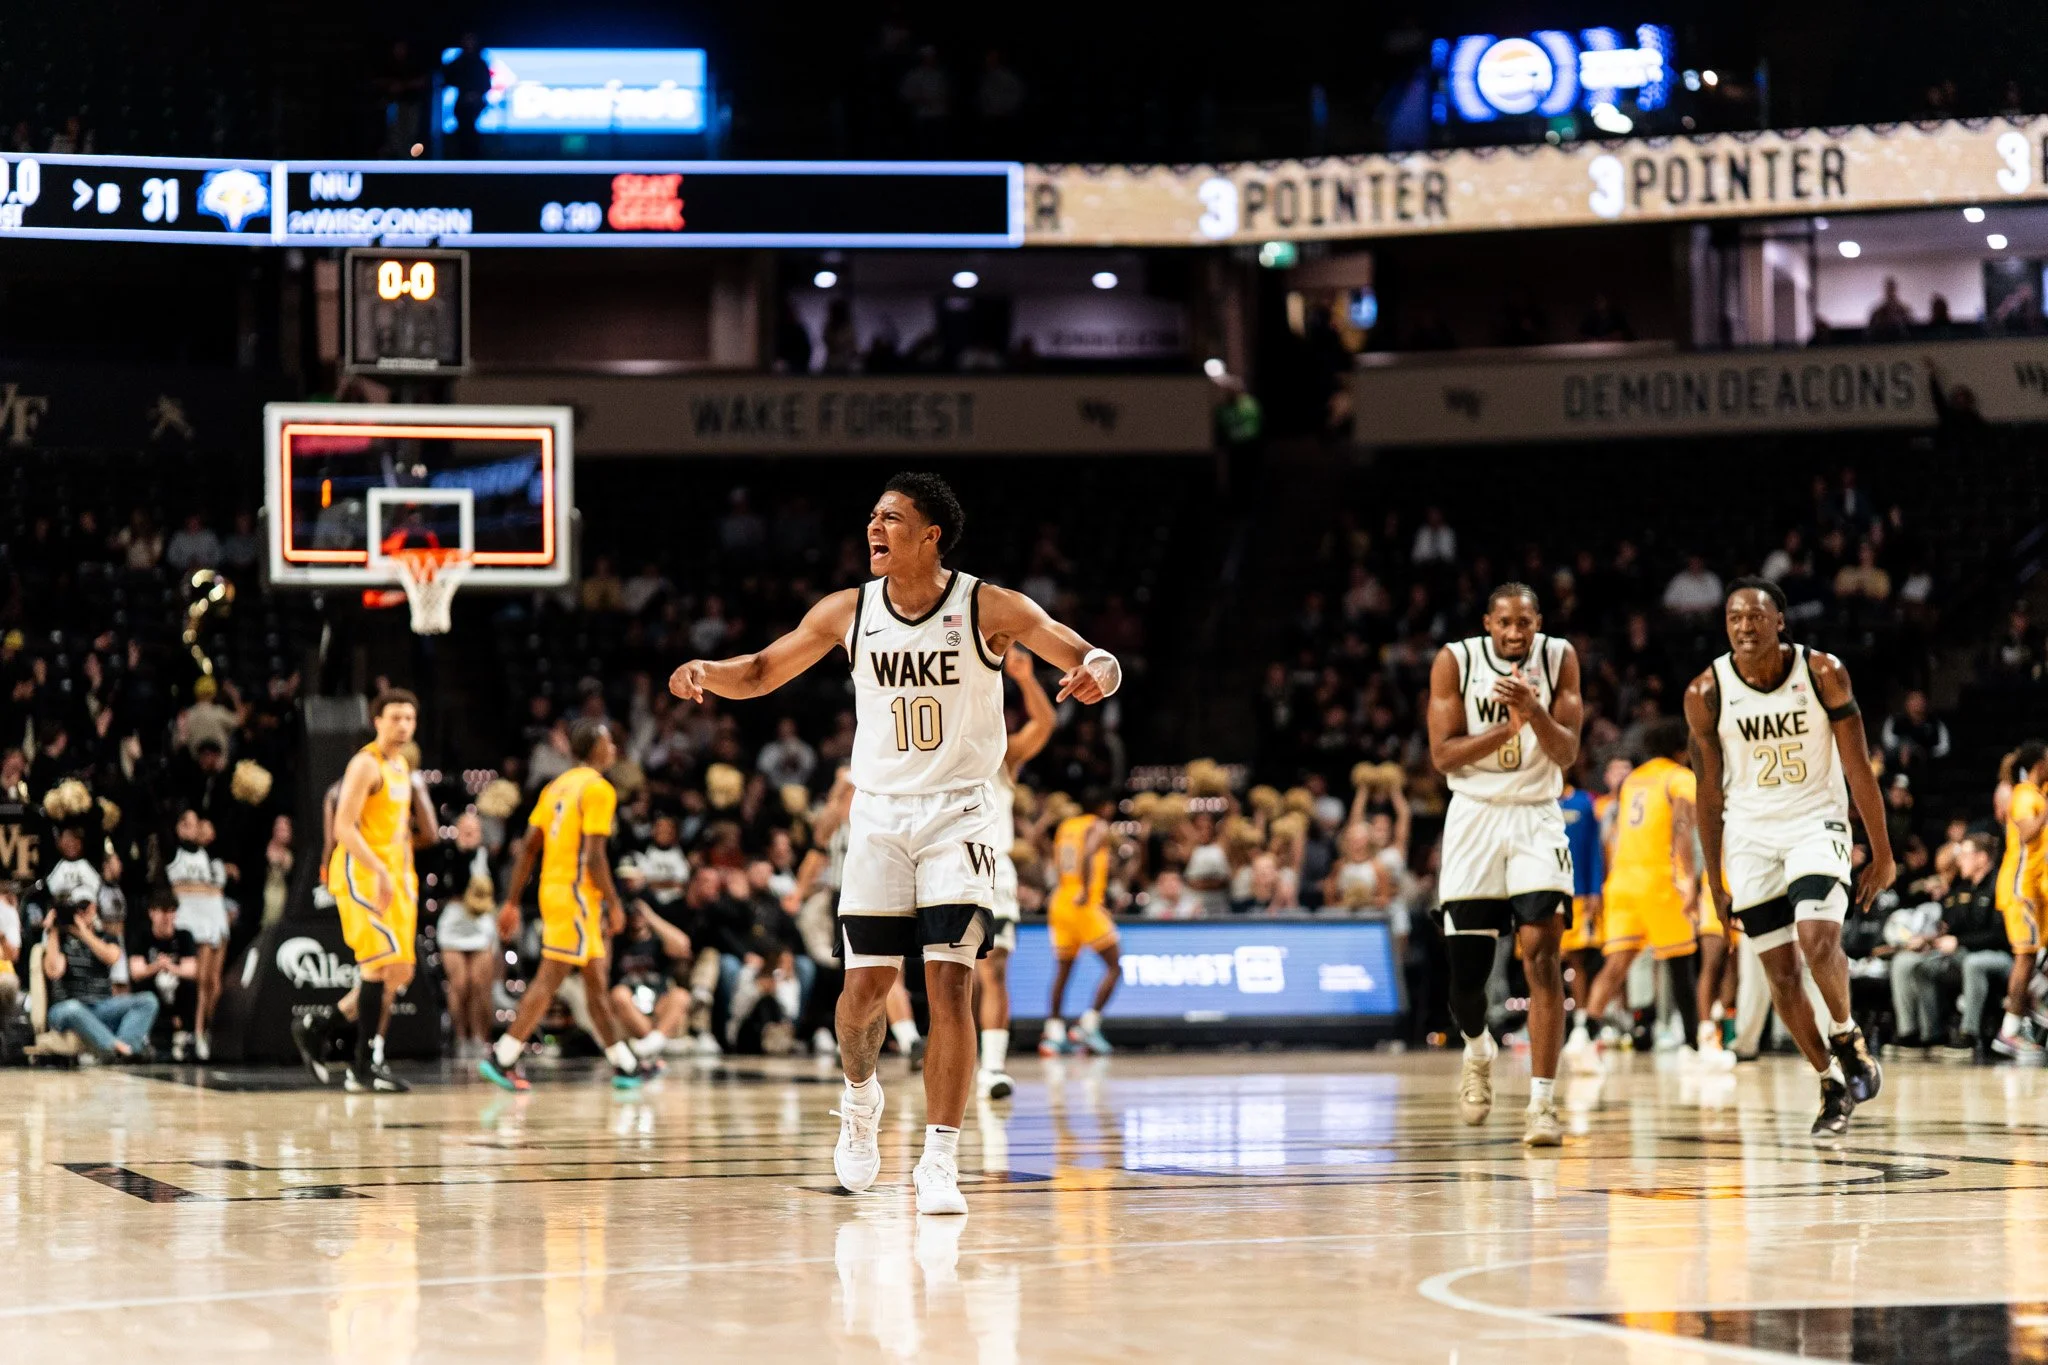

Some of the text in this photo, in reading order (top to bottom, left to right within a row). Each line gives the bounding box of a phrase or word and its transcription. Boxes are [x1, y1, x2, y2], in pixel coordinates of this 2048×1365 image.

[1588, 146, 1848, 218] 3 POINTER
[1996, 131, 2032, 195] 3
[142, 177, 179, 223] 31
[310, 171, 363, 201] NIU
[1199, 170, 1448, 240] 3 POINTER
[312, 207, 472, 234] WISCONSIN
[378, 260, 435, 300] 0.0
[1563, 362, 1916, 420] DEMON DEACONS
[692, 391, 975, 438] WAKE FOREST
[871, 651, 960, 687] WAKE
[891, 696, 943, 751] 10
[1475, 697, 1511, 723] WA
[1736, 710, 1809, 742] WAKE
[1753, 742, 1807, 786] 25
[1630, 788, 1648, 828] 5
[1118, 953, 1234, 987] TRUIST
